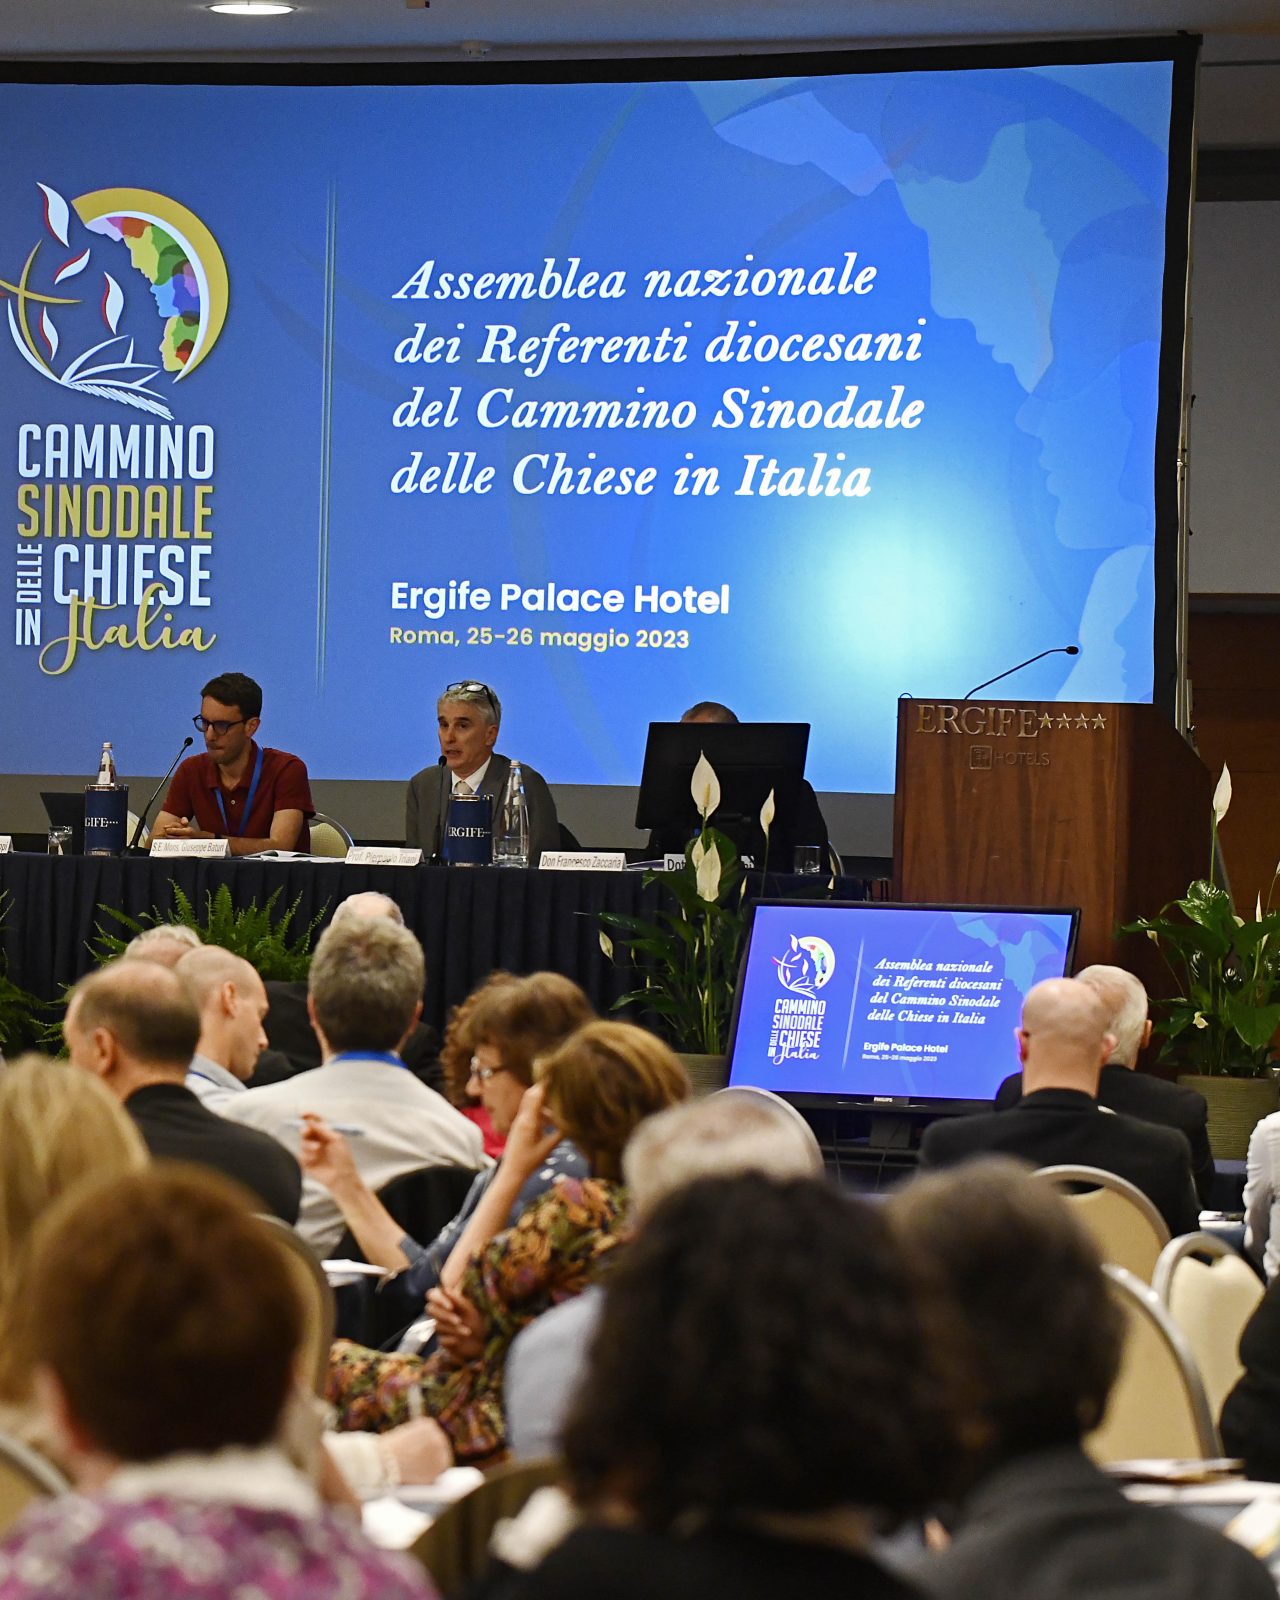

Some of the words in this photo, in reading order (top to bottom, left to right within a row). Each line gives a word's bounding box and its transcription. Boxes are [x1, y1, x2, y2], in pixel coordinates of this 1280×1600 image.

[392, 258, 626, 300] Assemblea
[644, 252, 877, 298] nazionale
[394, 323, 464, 364] dei
[477, 322, 692, 377] Referenti
[705, 318, 926, 362] diocesani
[393, 387, 461, 428] del
[477, 386, 696, 429] Cammino
[712, 385, 924, 429] Sinodale
[18, 424, 215, 480] CAMMINO
[390, 452, 495, 494] delle
[512, 452, 657, 496] Chiese
[673, 453, 720, 496] in
[734, 453, 872, 497] Italia
[17, 484, 213, 539] SINODALE
[16, 543, 42, 603] DELLE
[53, 543, 212, 606] CHIESE
[391, 580, 491, 619] Ergife
[501, 583, 624, 613] Palace
[634, 584, 730, 615] Hotel
[15, 608, 41, 645] IN
[39, 582, 217, 675] Italia
[390, 627, 460, 647] Roma,
[467, 627, 533, 646] 25-26
[541, 628, 629, 653] maggio
[635, 629, 689, 649] 2023
[916, 704, 1040, 738] ERGIFE
[994, 751, 1051, 767] HOTELS
[85, 817, 108, 828] GIFE
[541, 855, 556, 867] Don
[557, 856, 591, 868] Francesco
[592, 856, 622, 869] Zaccaria
[874, 958, 933, 971] Assemblea
[936, 960, 993, 972] nazionale
[872, 975, 892, 987] dei
[893, 976, 948, 991] Referenti
[949, 977, 1003, 990] diocesani
[775, 999, 826, 1015] CAMMINO
[870, 992, 889, 1003] del
[891, 993, 946, 1006] Cammino
[948, 994, 1000, 1007] Sinodale
[772, 1014, 824, 1030] SINODALE
[867, 1009, 895, 1021] delle
[898, 1010, 934, 1022] Chiese
[937, 1011, 949, 1023] in
[952, 1012, 985, 1024] Italia
[779, 1030, 822, 1048] CHIESE
[864, 1042, 890, 1053] Ergife
[891, 1043, 922, 1052] Palace
[924, 1044, 948, 1054] Hotel
